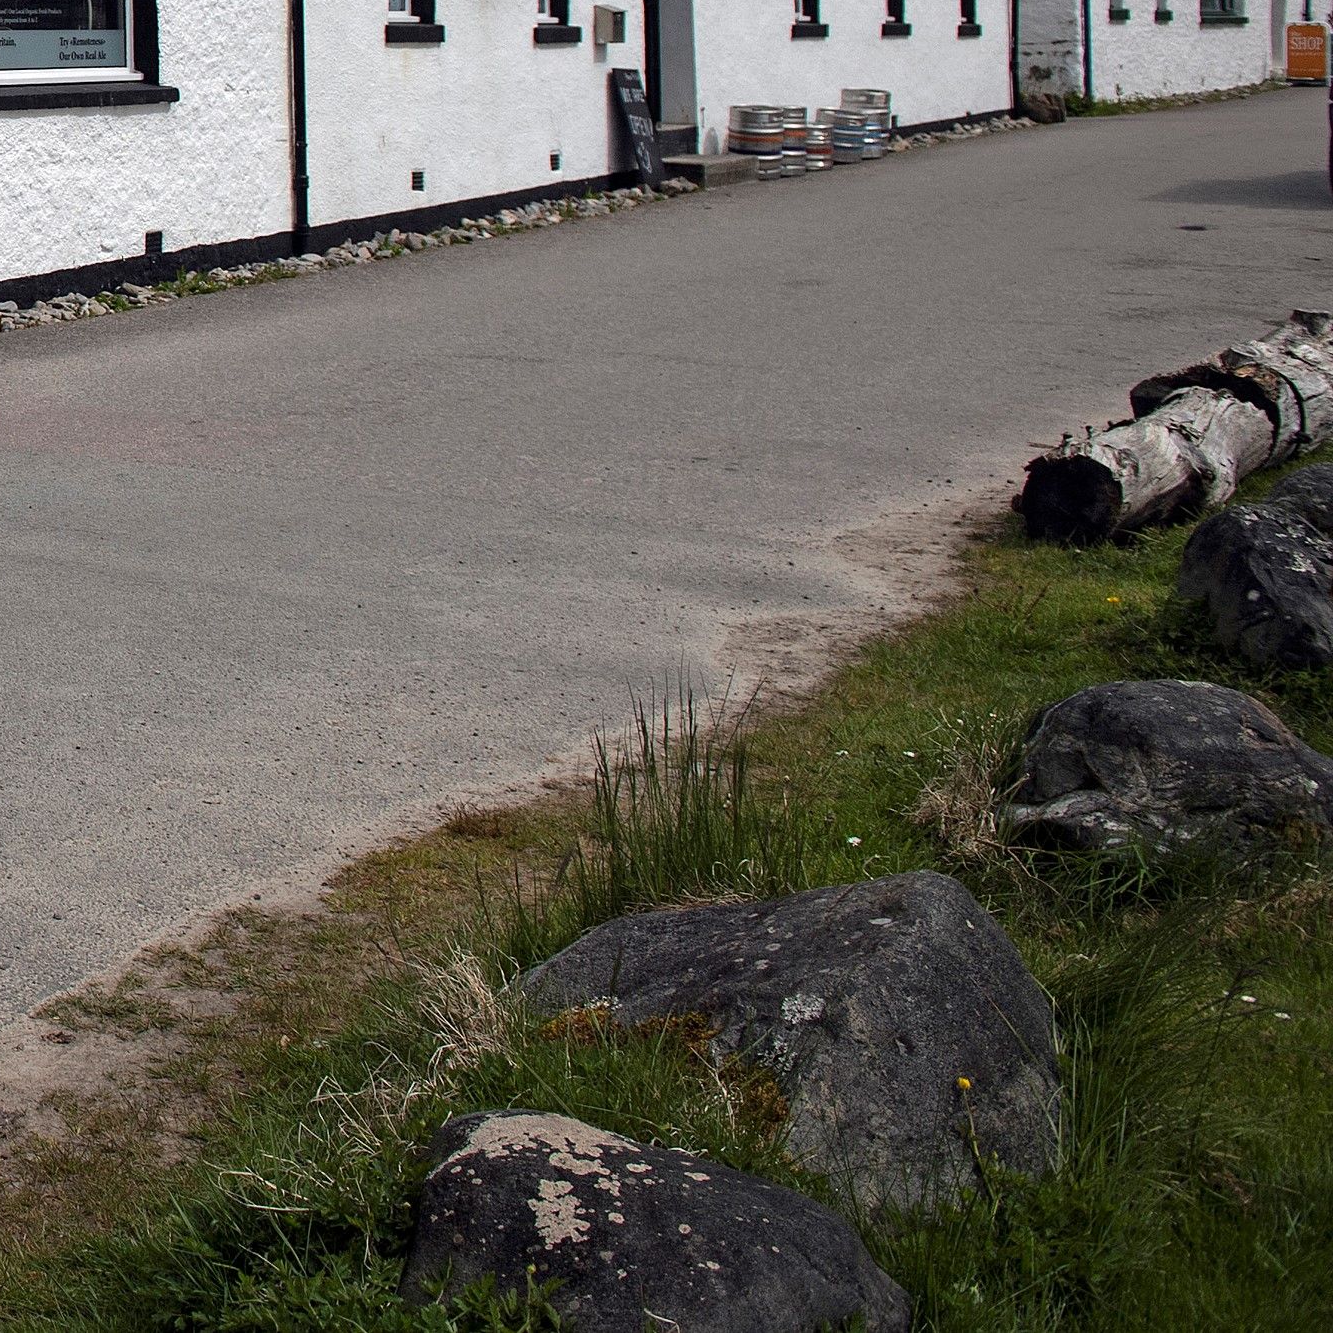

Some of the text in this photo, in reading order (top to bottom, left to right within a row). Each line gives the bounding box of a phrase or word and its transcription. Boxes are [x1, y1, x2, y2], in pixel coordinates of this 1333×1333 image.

[59, 37, 68, 48] Try
[1291, 37, 1323, 50] SHOP
[59, 50, 106, 60] Our Own Real Ale
